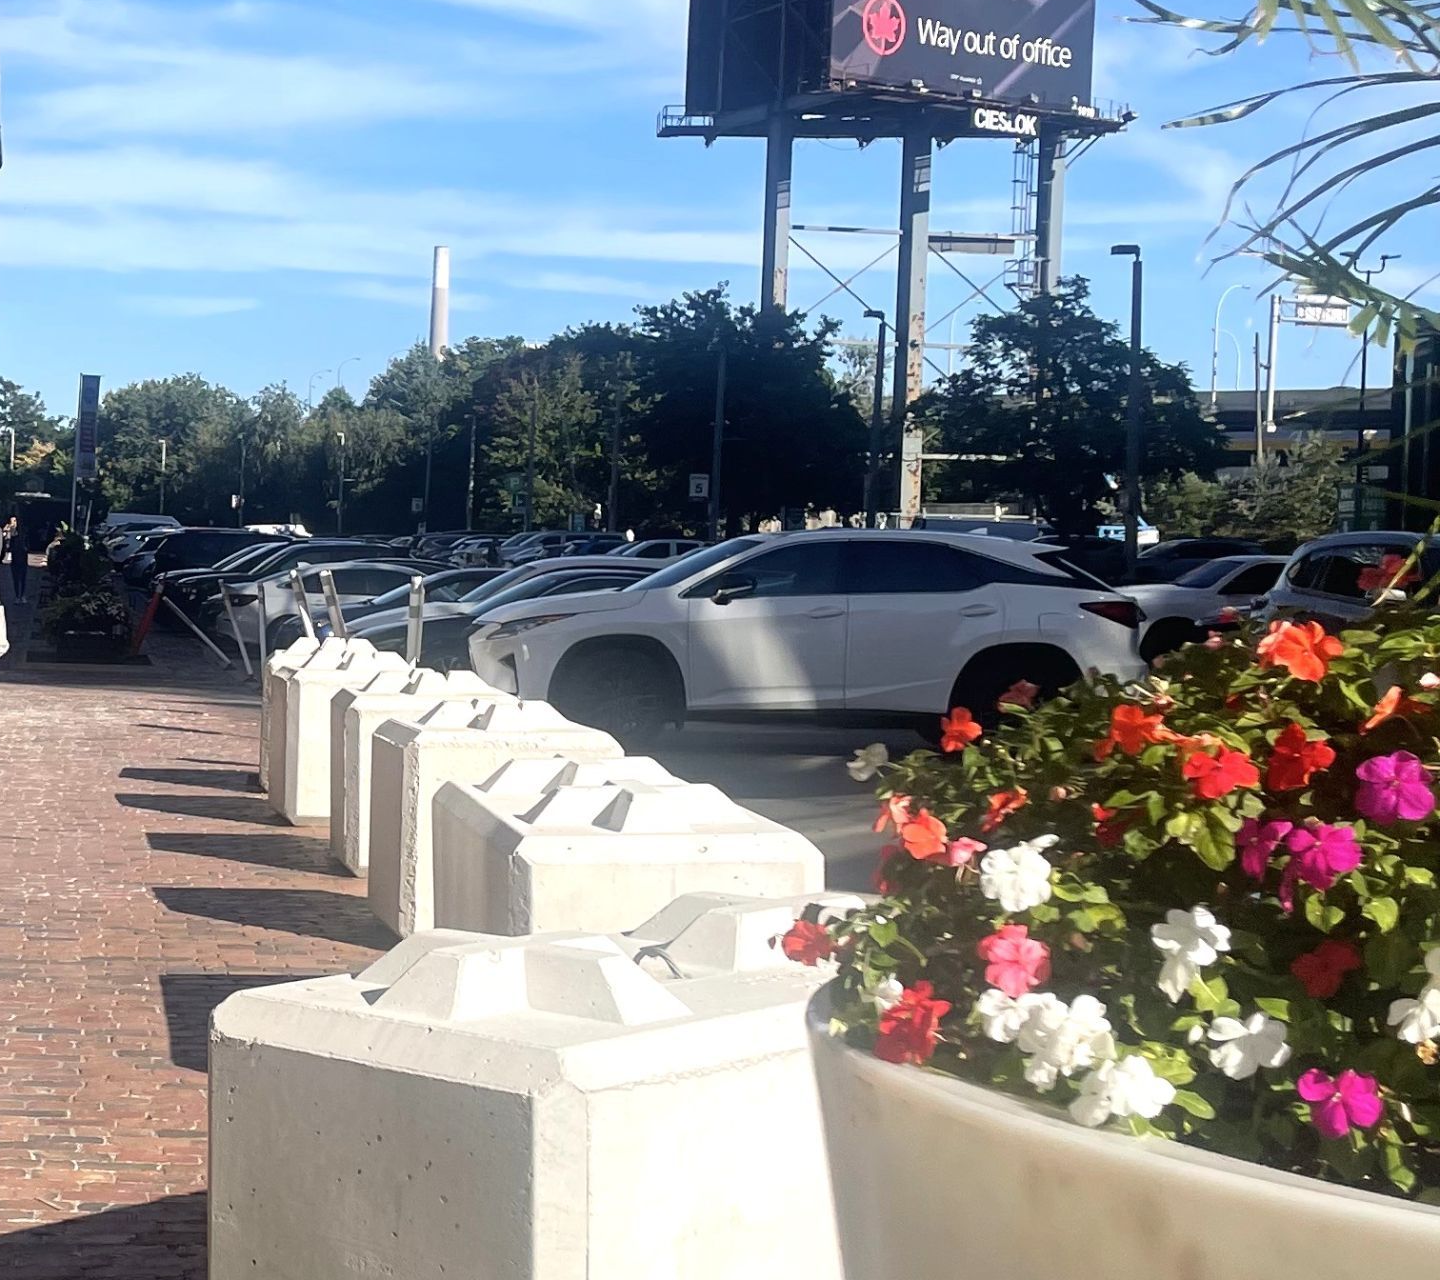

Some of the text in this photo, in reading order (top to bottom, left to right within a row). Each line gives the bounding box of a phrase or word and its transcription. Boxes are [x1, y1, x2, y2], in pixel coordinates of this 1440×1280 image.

[917, 18, 1072, 68] Way out of office
[695, 483, 703, 493] 5
